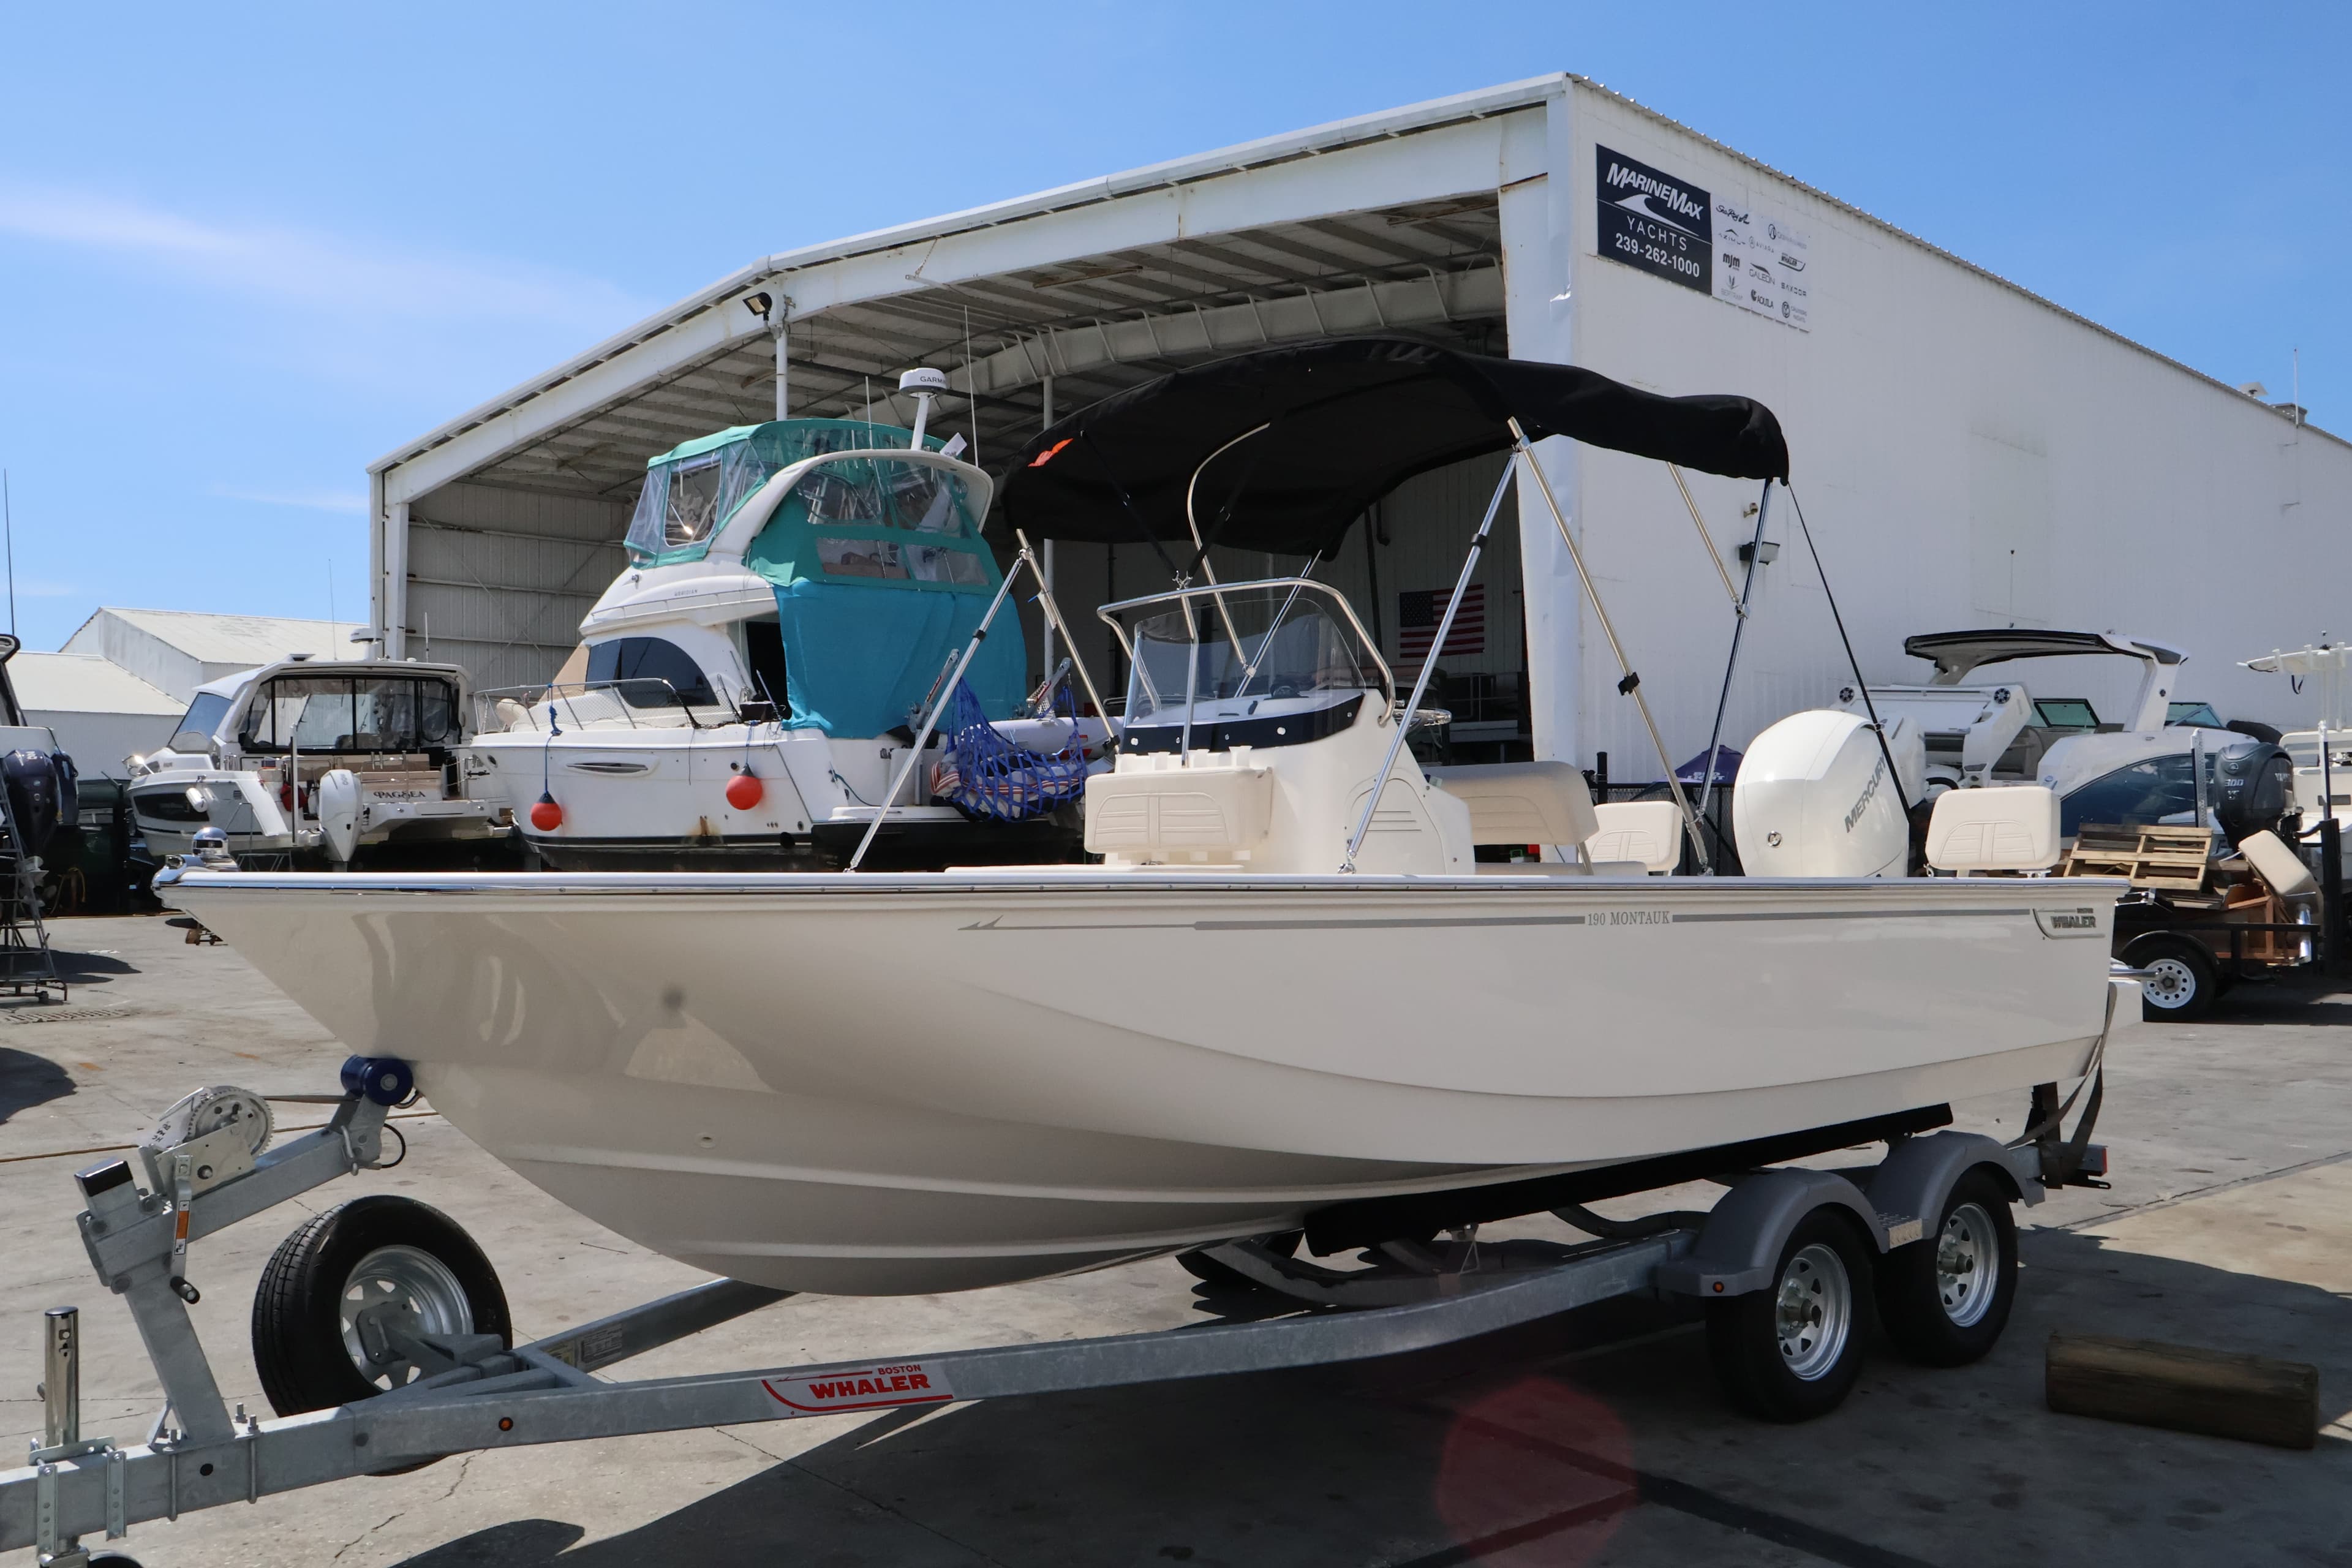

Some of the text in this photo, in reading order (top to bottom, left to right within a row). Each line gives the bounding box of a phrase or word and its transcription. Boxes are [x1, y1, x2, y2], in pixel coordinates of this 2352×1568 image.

[1627, 215, 1687, 251] YACHTS
[1615, 232, 1700, 277] 239-262-1000
[1749, 269, 1775, 285] GALEON
[1844, 749, 1886, 834] MERCURY
[2225, 778, 2244, 787] 300
[1588, 911, 1670, 926] 190 MONTAUK
[878, 1364, 922, 1376] BOSTON
[809, 1373, 931, 1399] WHALER
